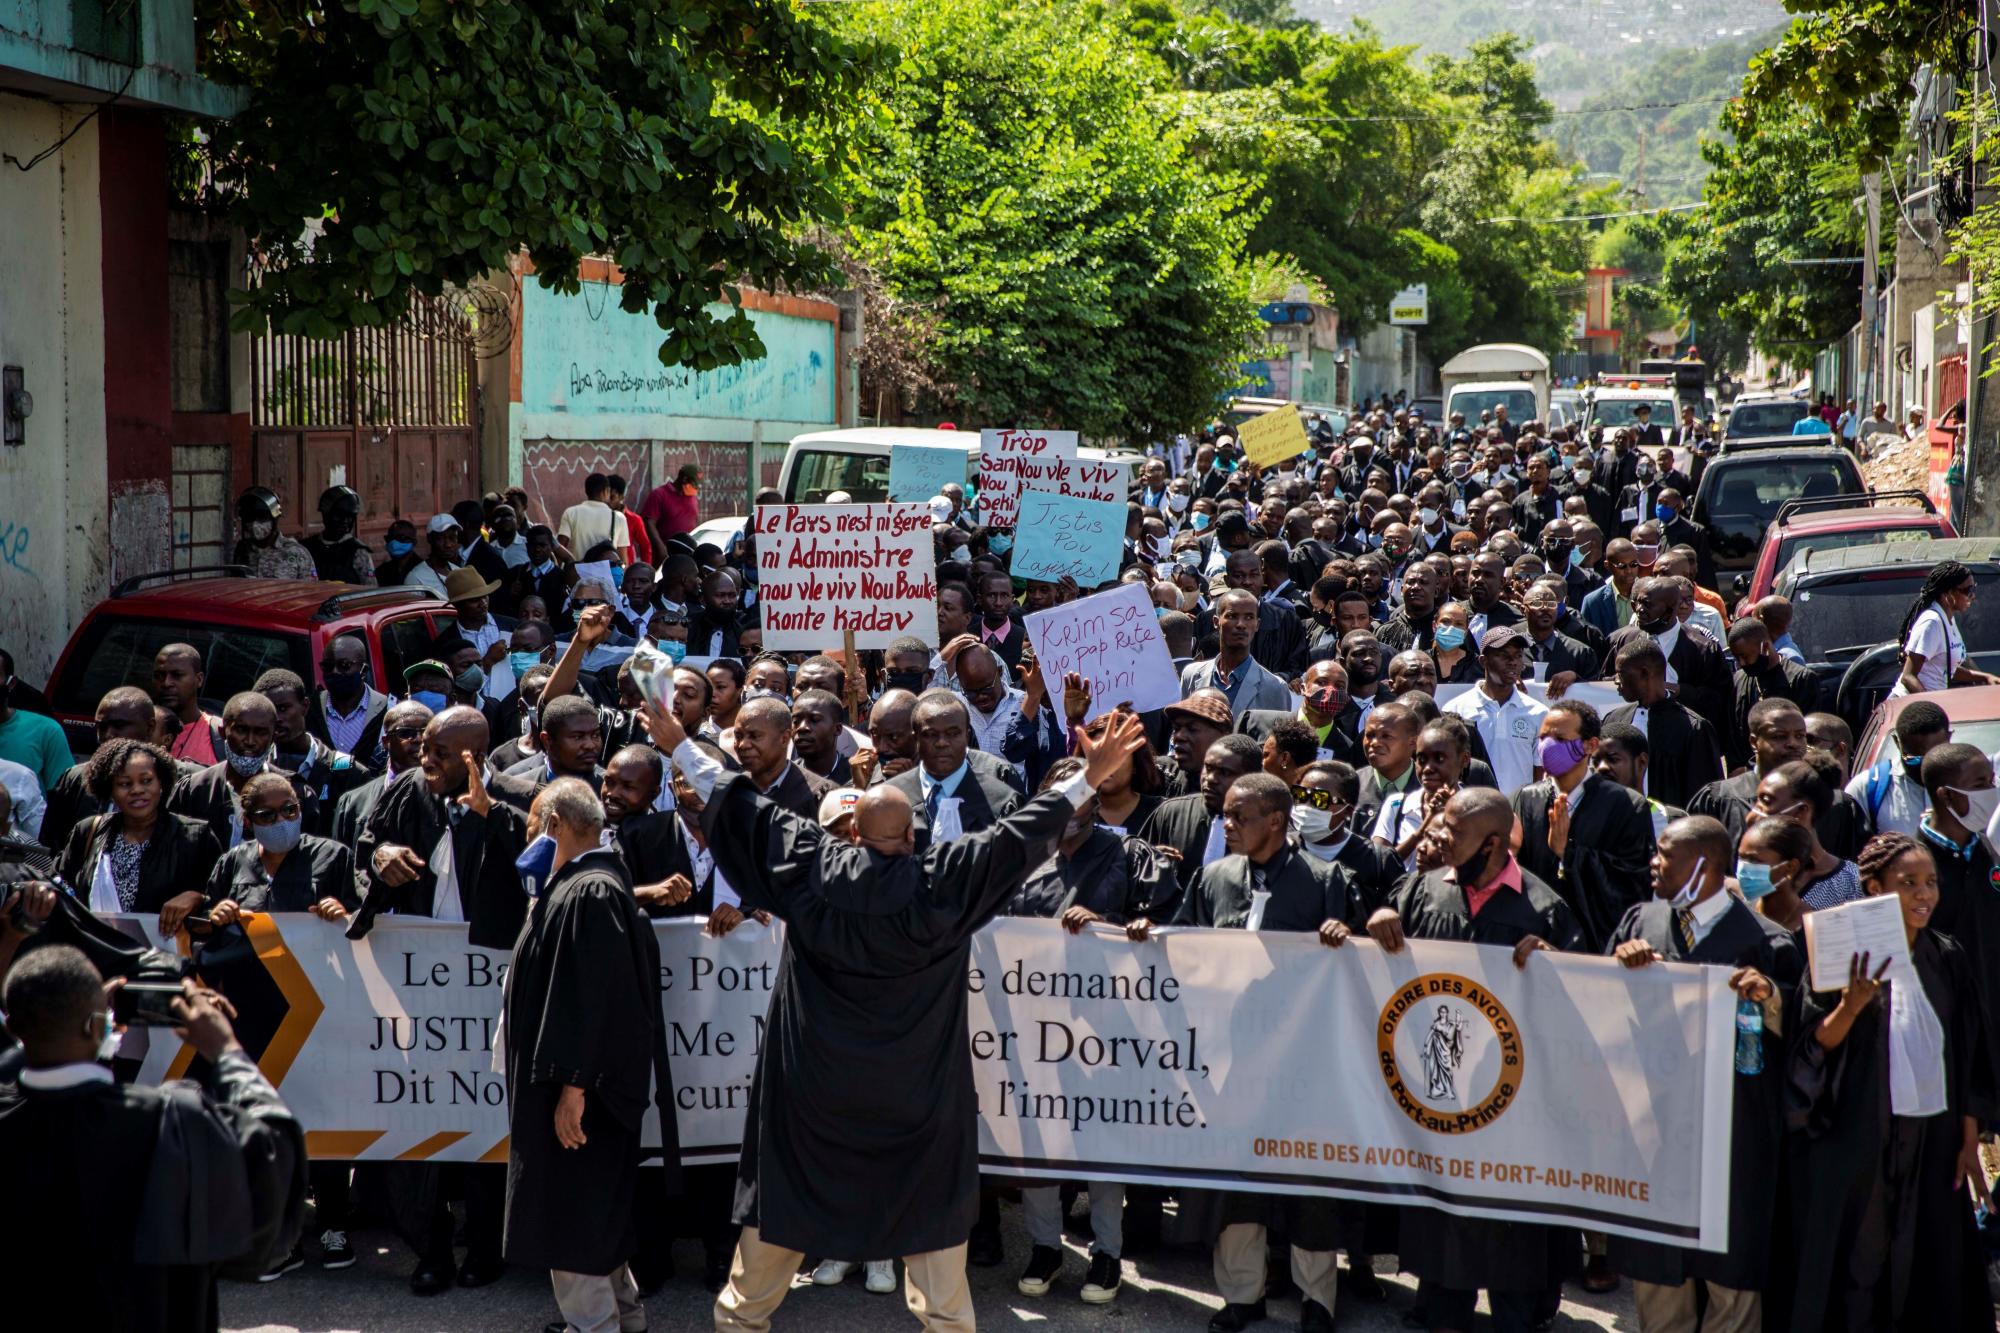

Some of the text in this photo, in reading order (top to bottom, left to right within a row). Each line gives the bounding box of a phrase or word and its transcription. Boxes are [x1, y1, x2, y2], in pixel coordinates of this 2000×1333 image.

[997, 429, 1047, 455] Tròp
[980, 473, 1007, 491] Nou
[1016, 456, 1042, 479] Nou
[1080, 462, 1118, 483] viv
[980, 493, 1015, 511] Seki
[1032, 502, 1104, 534] Jistis
[755, 505, 781, 534] Le
[785, 505, 832, 534] Pays
[837, 504, 873, 532] n'est
[876, 504, 892, 532] ni
[761, 536, 914, 569] ni Administre
[1055, 532, 1092, 553] Pou
[759, 570, 938, 602] nou vle viv Nou Bouke
[1048, 654, 1070, 694] yo
[1075, 639, 1108, 675] pap
[402, 952, 450, 987] Le
[464, 953, 509, 988] Ba
[660, 966, 673, 991] e
[688, 956, 774, 991] Port
[1001, 959, 1180, 1002] demande
[1383, 983, 1426, 1035] ORDRE
[1429, 979, 1463, 994] DES
[1467, 988, 1518, 1066] AVOCATS
[369, 1016, 494, 1051] JUSTI
[669, 1021, 735, 1056] Me
[971, 1029, 1018, 1061] er
[1034, 1020, 1210, 1079] Dorval,
[373, 1069, 436, 1104] Dit
[447, 1070, 504, 1106] No
[676, 1074, 751, 1110] curi
[998, 1080, 1207, 1132] l'impunité.
[1381, 1051, 1395, 1078] de
[1391, 1082, 1514, 1133] Port-au-Prince
[1253, 1137, 1650, 1202] ORDRE DES AVOCATS DE PORT-AU-PRINCE
